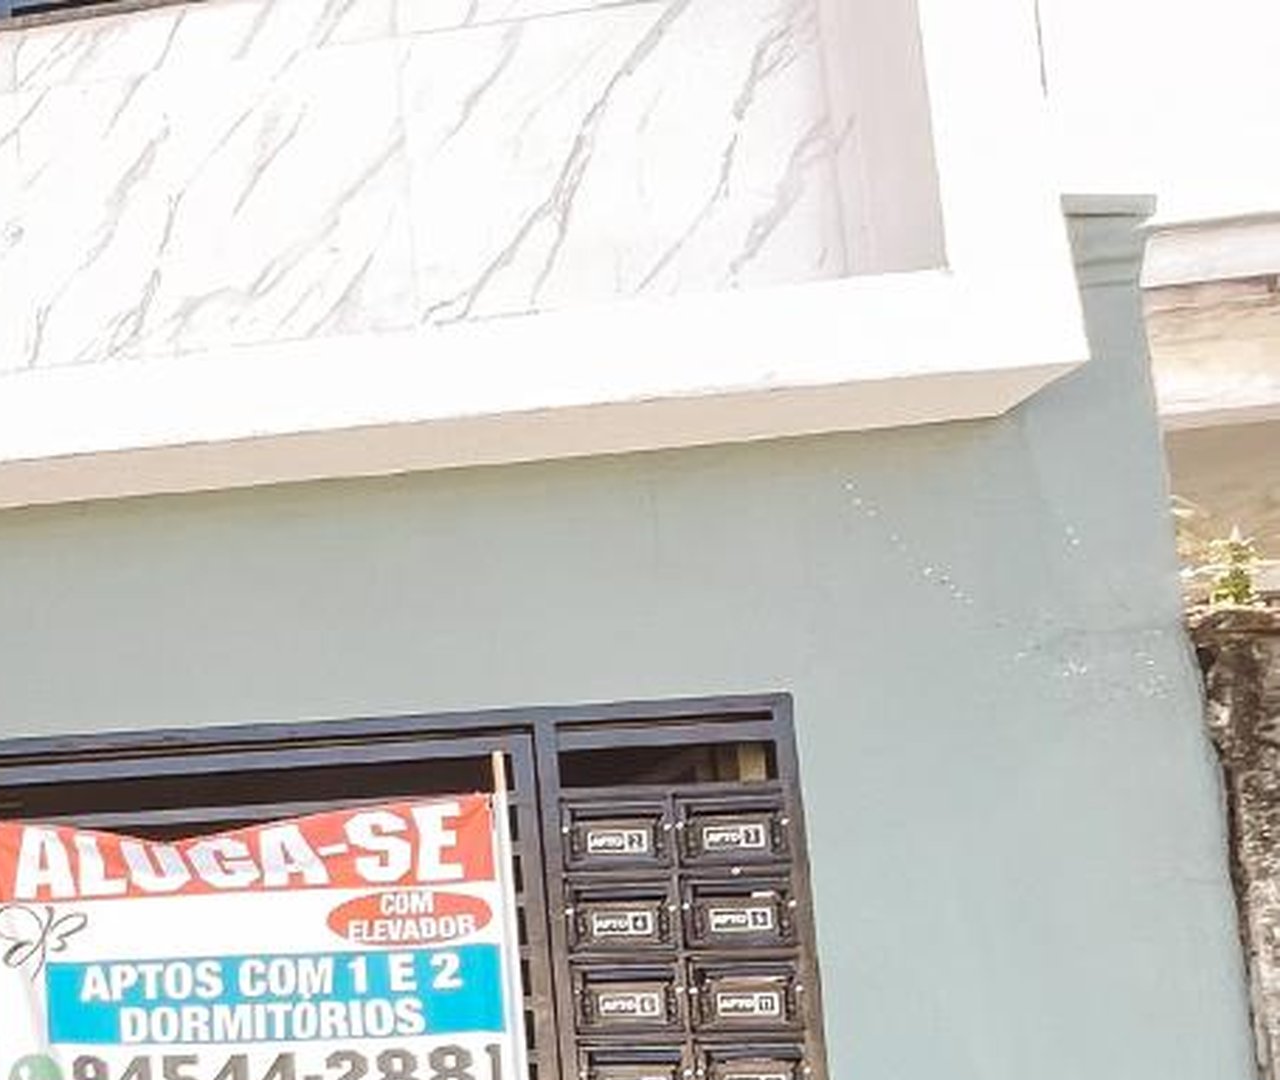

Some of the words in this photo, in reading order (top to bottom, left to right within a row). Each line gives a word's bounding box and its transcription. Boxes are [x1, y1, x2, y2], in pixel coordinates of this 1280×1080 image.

[13, 801, 465, 900] ALUGA-SE
[347, 913, 476, 943] ELEVADOR
[379, 892, 435, 916] COM
[80, 961, 223, 1002] APTOS
[238, 959, 333, 999] COM
[347, 959, 369, 993] 1
[389, 956, 418, 992] E
[432, 953, 464, 990] 2
[119, 994, 427, 1044] DORMITÓRIOS
